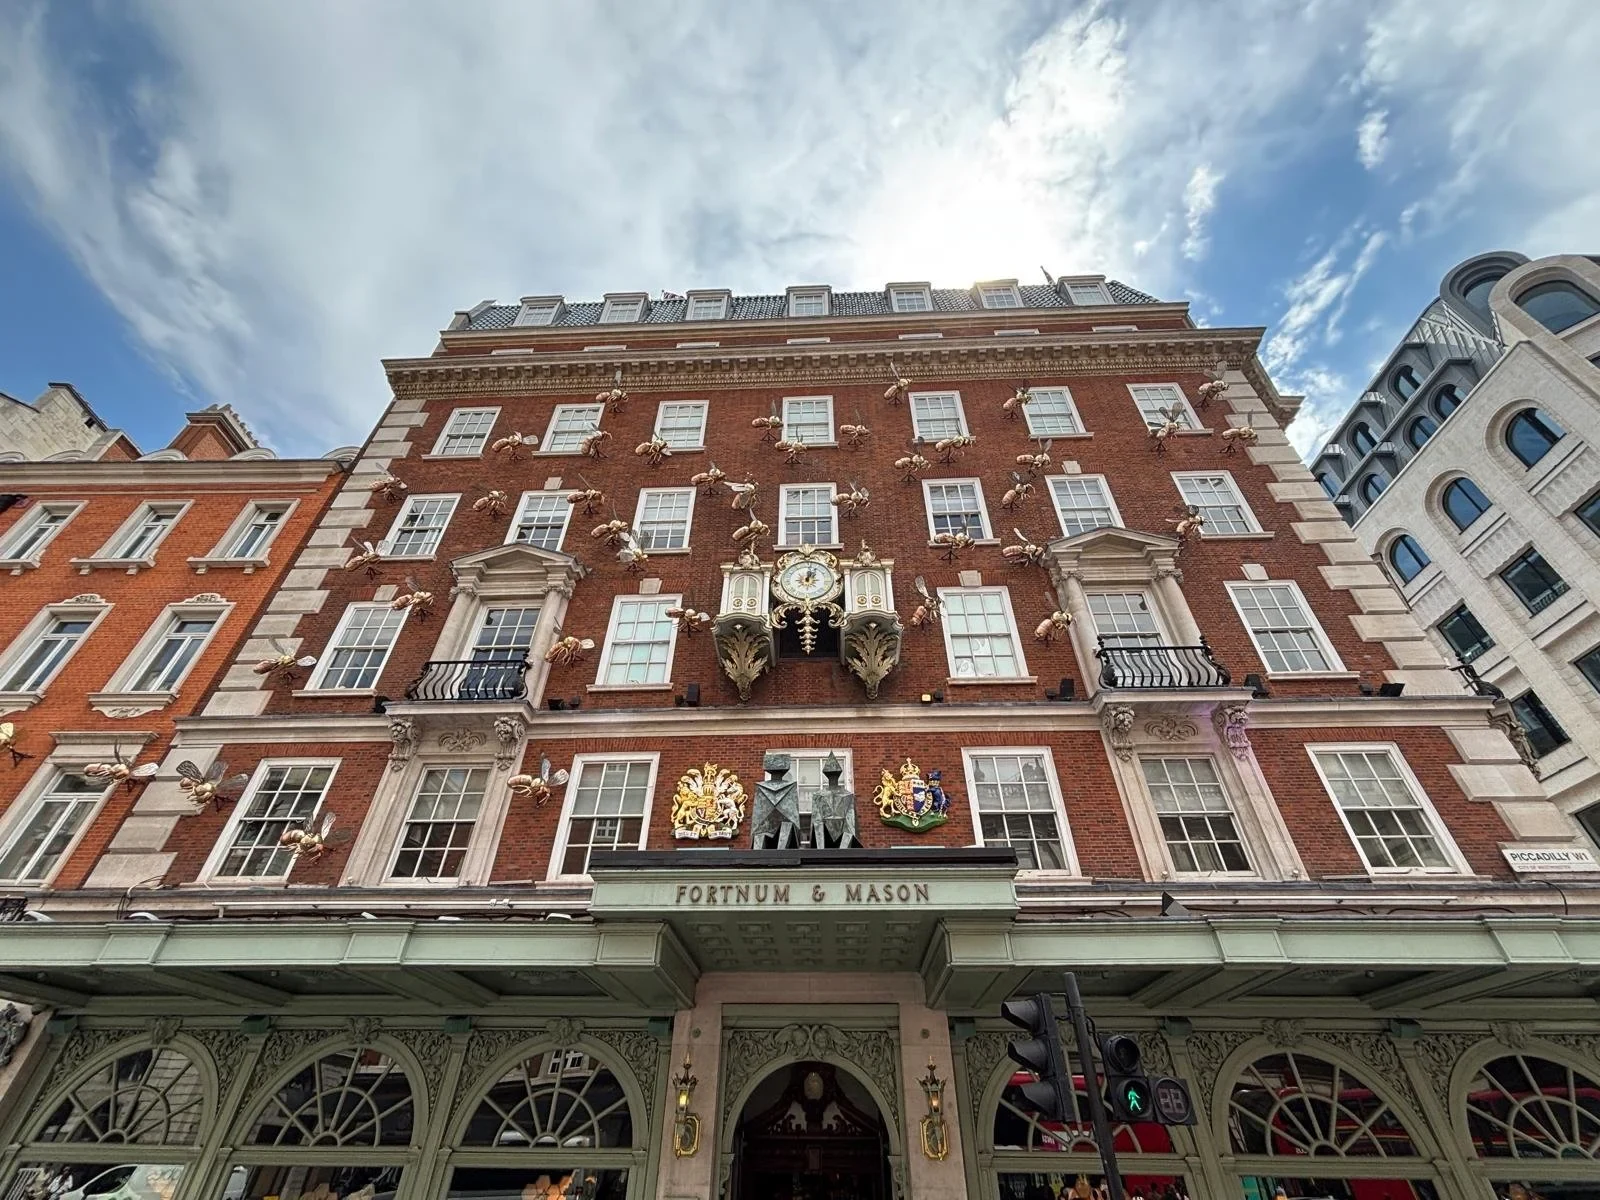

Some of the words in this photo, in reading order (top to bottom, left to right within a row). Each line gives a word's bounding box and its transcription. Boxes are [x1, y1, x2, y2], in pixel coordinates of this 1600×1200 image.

[1510, 852, 1571, 861] PICCADILLY
[1571, 852, 1589, 861] W1
[675, 884, 790, 904] FORTNUM
[811, 884, 826, 903] &
[845, 883, 930, 903] MASON
